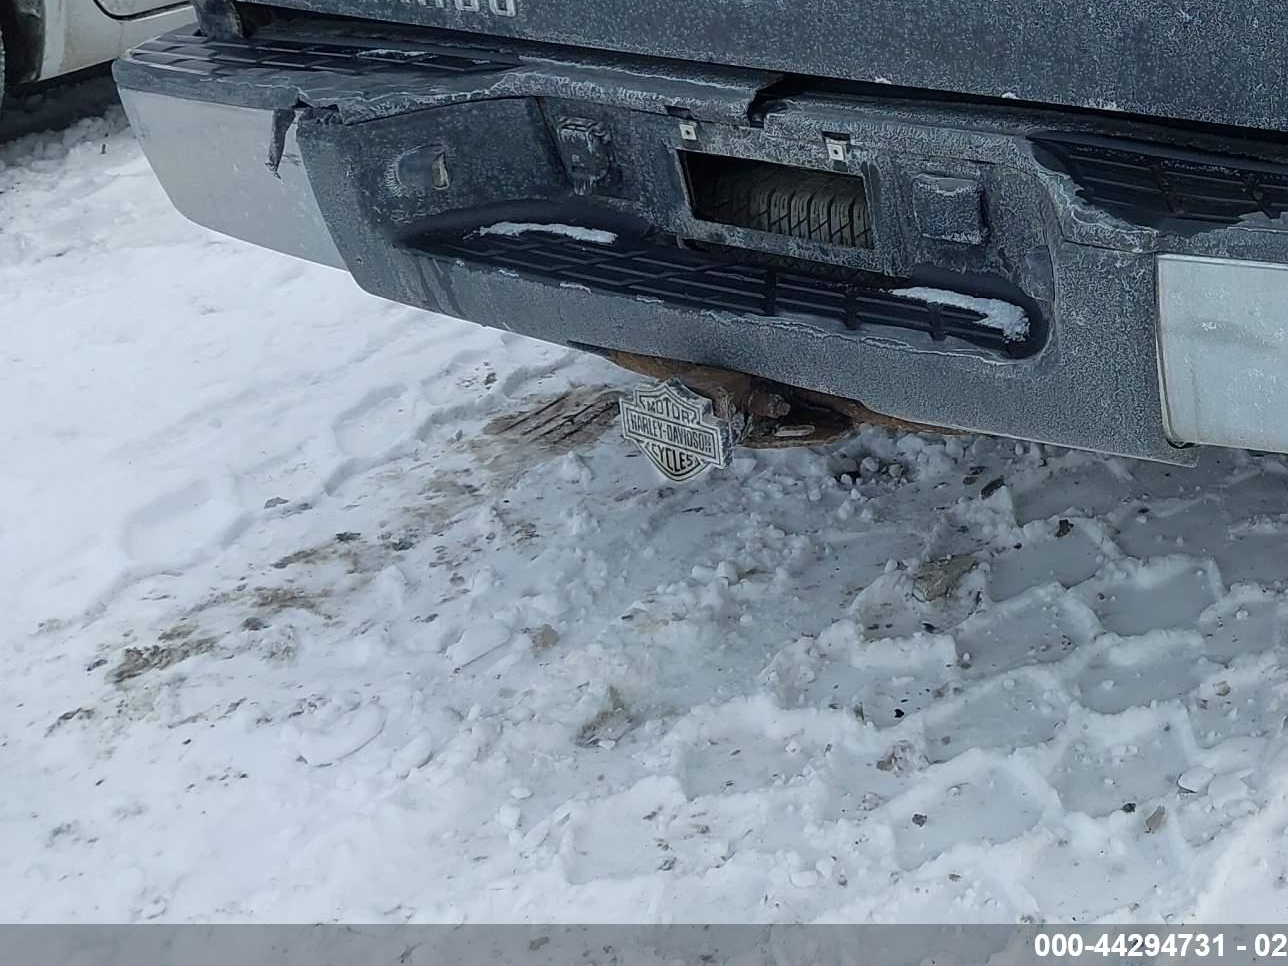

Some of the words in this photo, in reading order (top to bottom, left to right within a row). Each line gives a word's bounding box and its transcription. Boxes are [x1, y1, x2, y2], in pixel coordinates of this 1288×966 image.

[646, 396, 690, 425] MOTOR
[630, 411, 713, 454] HARLEY-DAVIDSON
[651, 443, 694, 473] CYCLES
